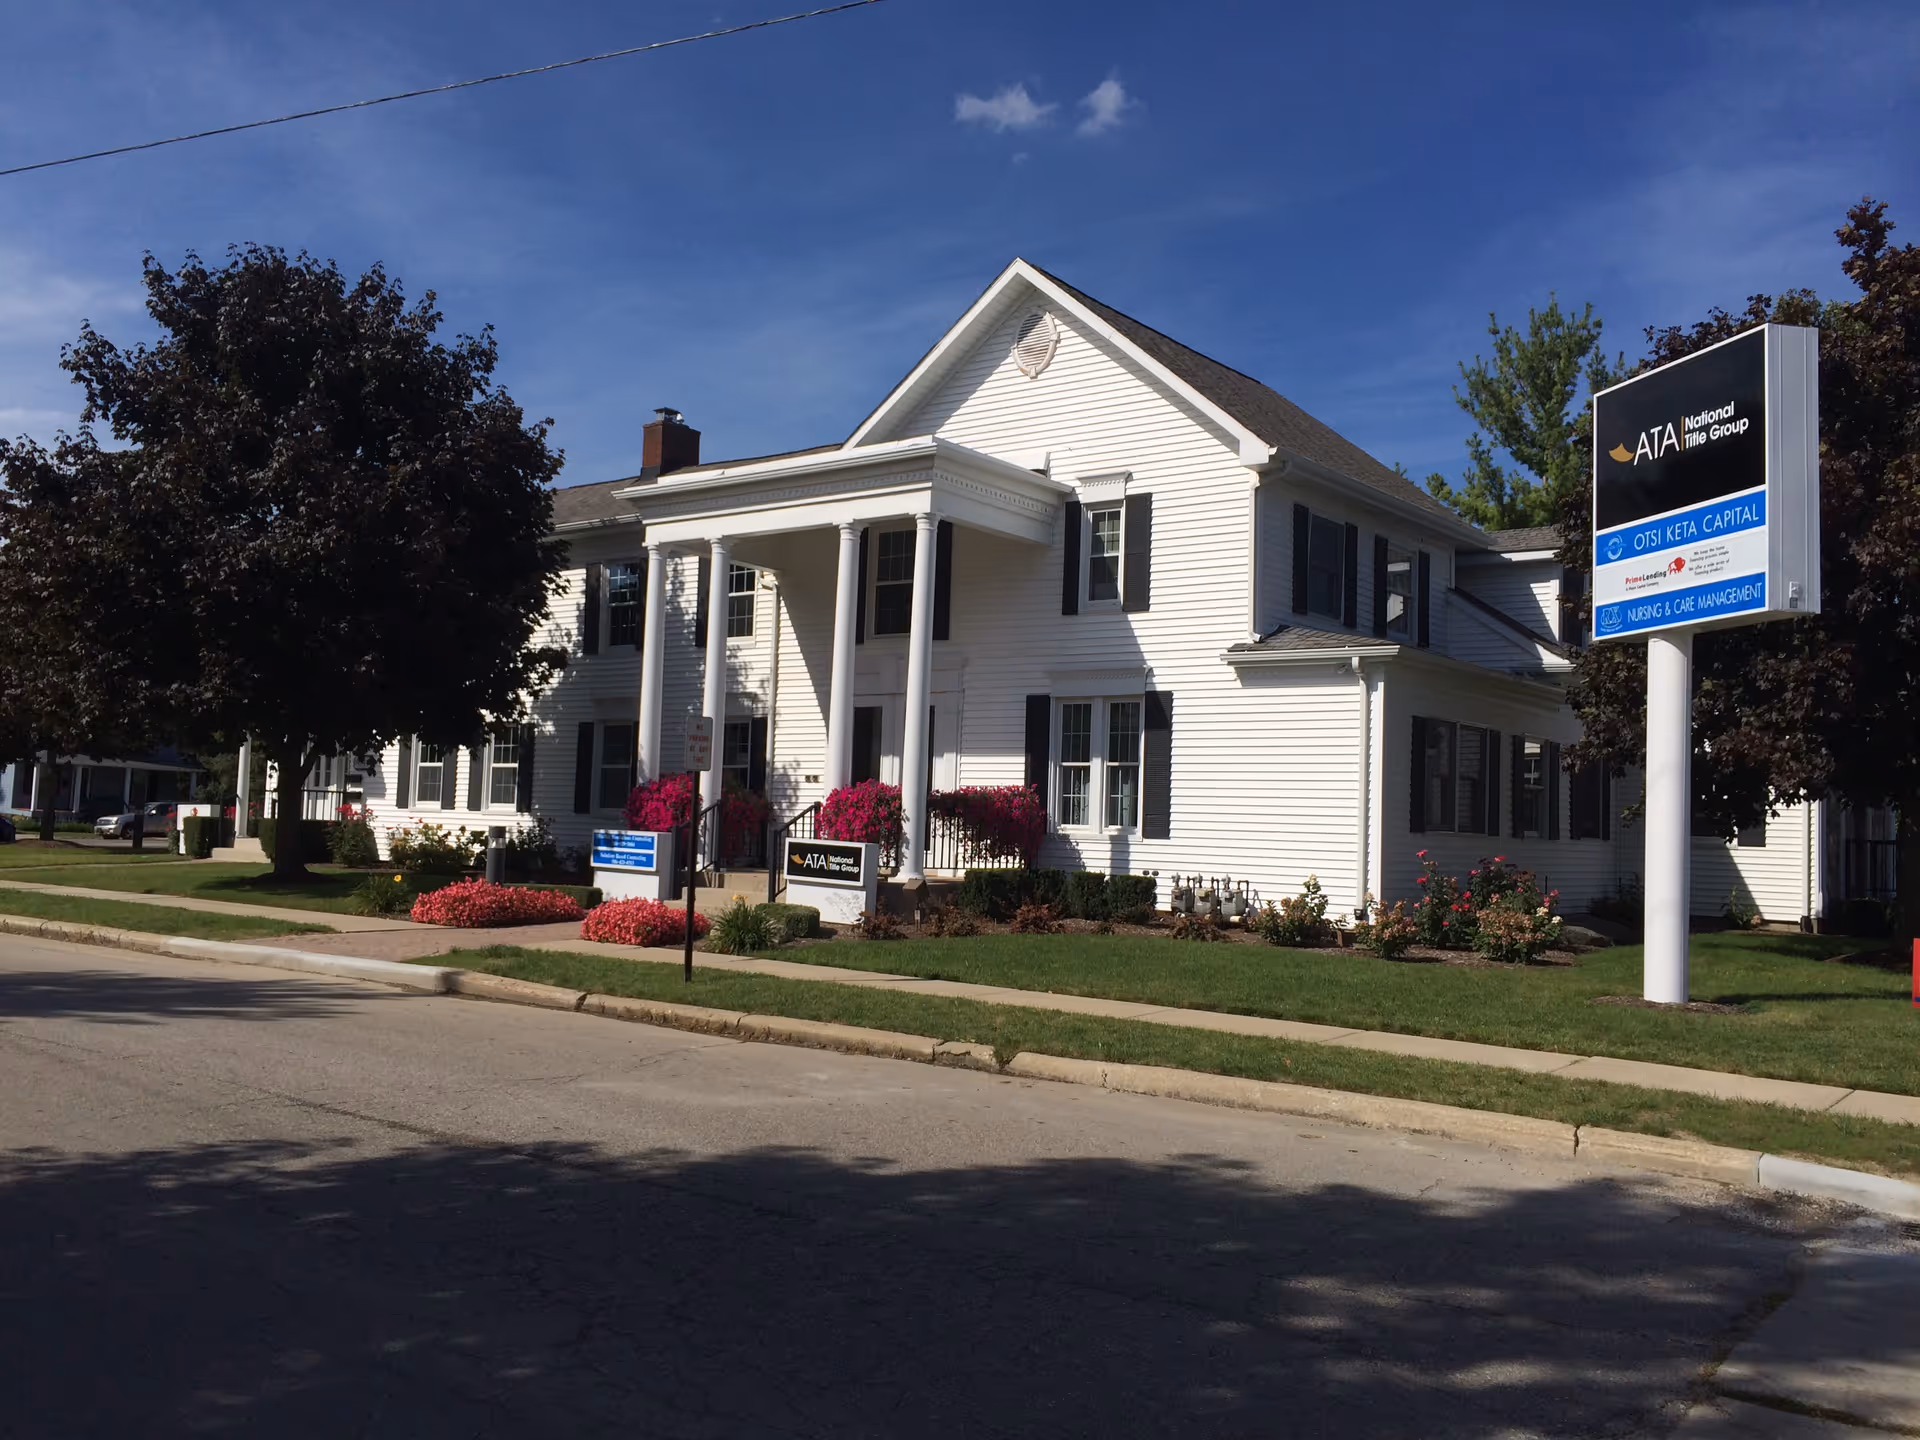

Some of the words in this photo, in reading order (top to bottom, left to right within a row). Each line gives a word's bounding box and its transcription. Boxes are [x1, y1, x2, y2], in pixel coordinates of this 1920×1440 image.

[1684, 400, 1735, 431] National
[1633, 422, 1680, 466] ATA
[1684, 431, 1707, 450] Title
[1709, 417, 1750, 441] Group
[1634, 529, 1662, 550] OTSI
[1666, 520, 1698, 543] KETA
[1702, 503, 1760, 533] CAPITAL
[1625, 570, 1667, 585] PrimeLending
[1627, 604, 1662, 623] NURSING
[1665, 601, 1671, 616] &
[1673, 595, 1695, 614] CARE
[1698, 582, 1763, 610] MANAGEMENT
[803, 853, 827, 870] ATA
[829, 855, 854, 864] National
[829, 863, 840, 871] Title
[841, 864, 860, 873] Group
